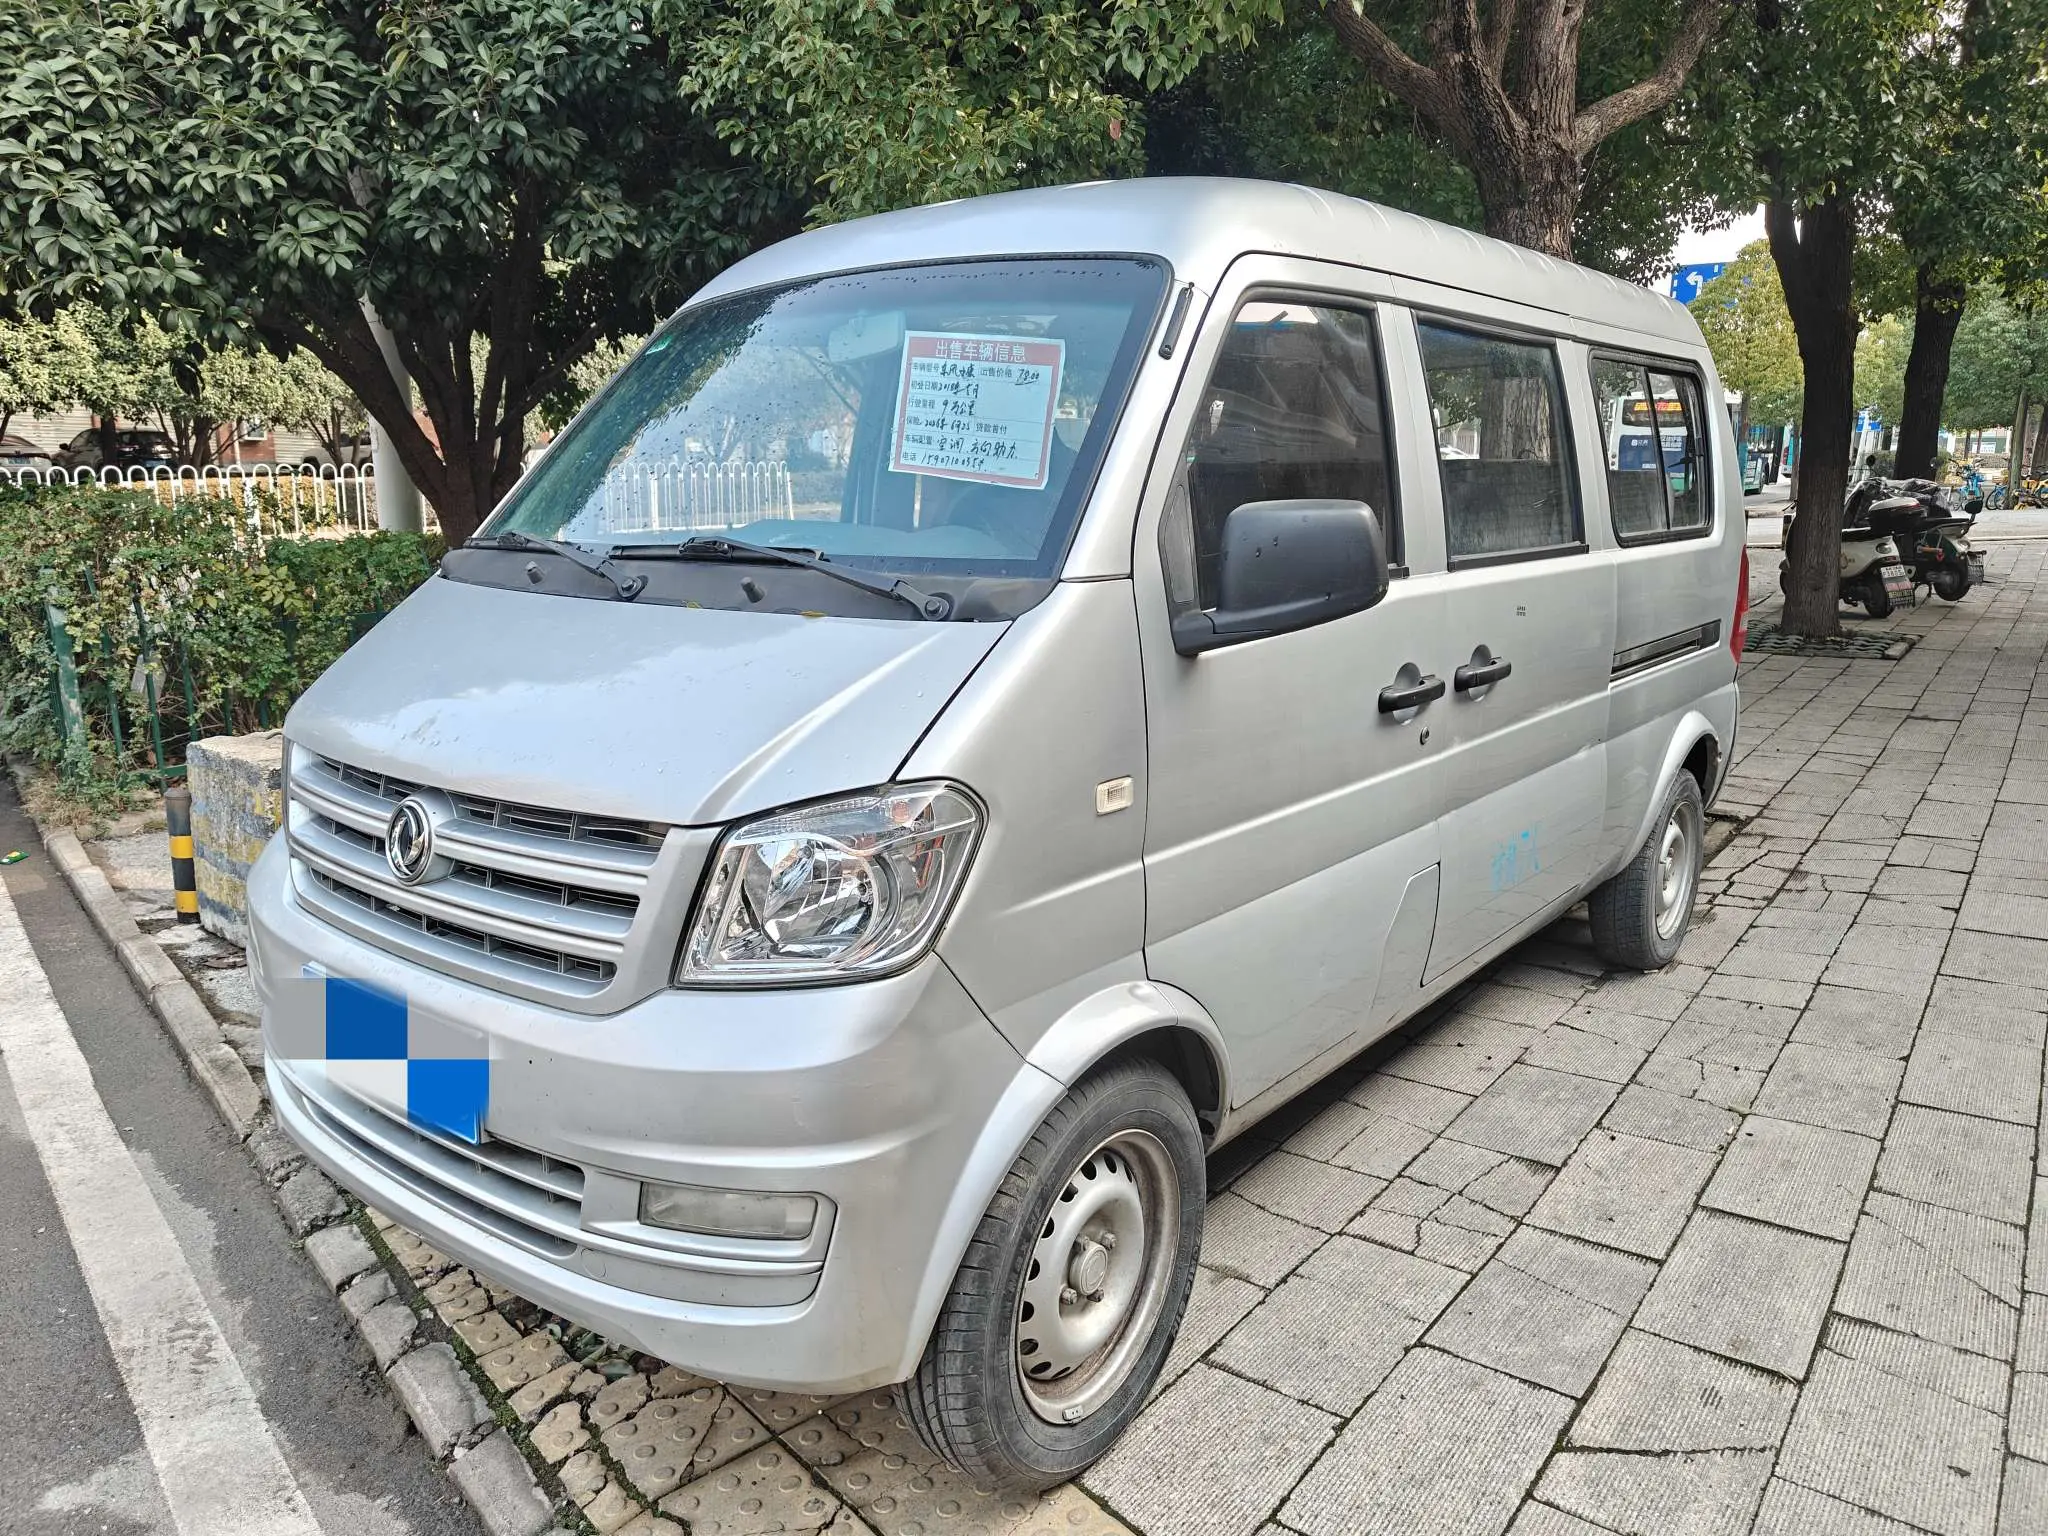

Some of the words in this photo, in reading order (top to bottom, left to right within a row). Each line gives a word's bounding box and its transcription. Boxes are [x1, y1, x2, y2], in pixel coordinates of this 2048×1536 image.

[936, 339, 1026, 362] 出售车辆信息
[980, 367, 1013, 378] 出售价格
[975, 422, 1007, 434] 贷款首付
[902, 453, 917, 463] 电话
